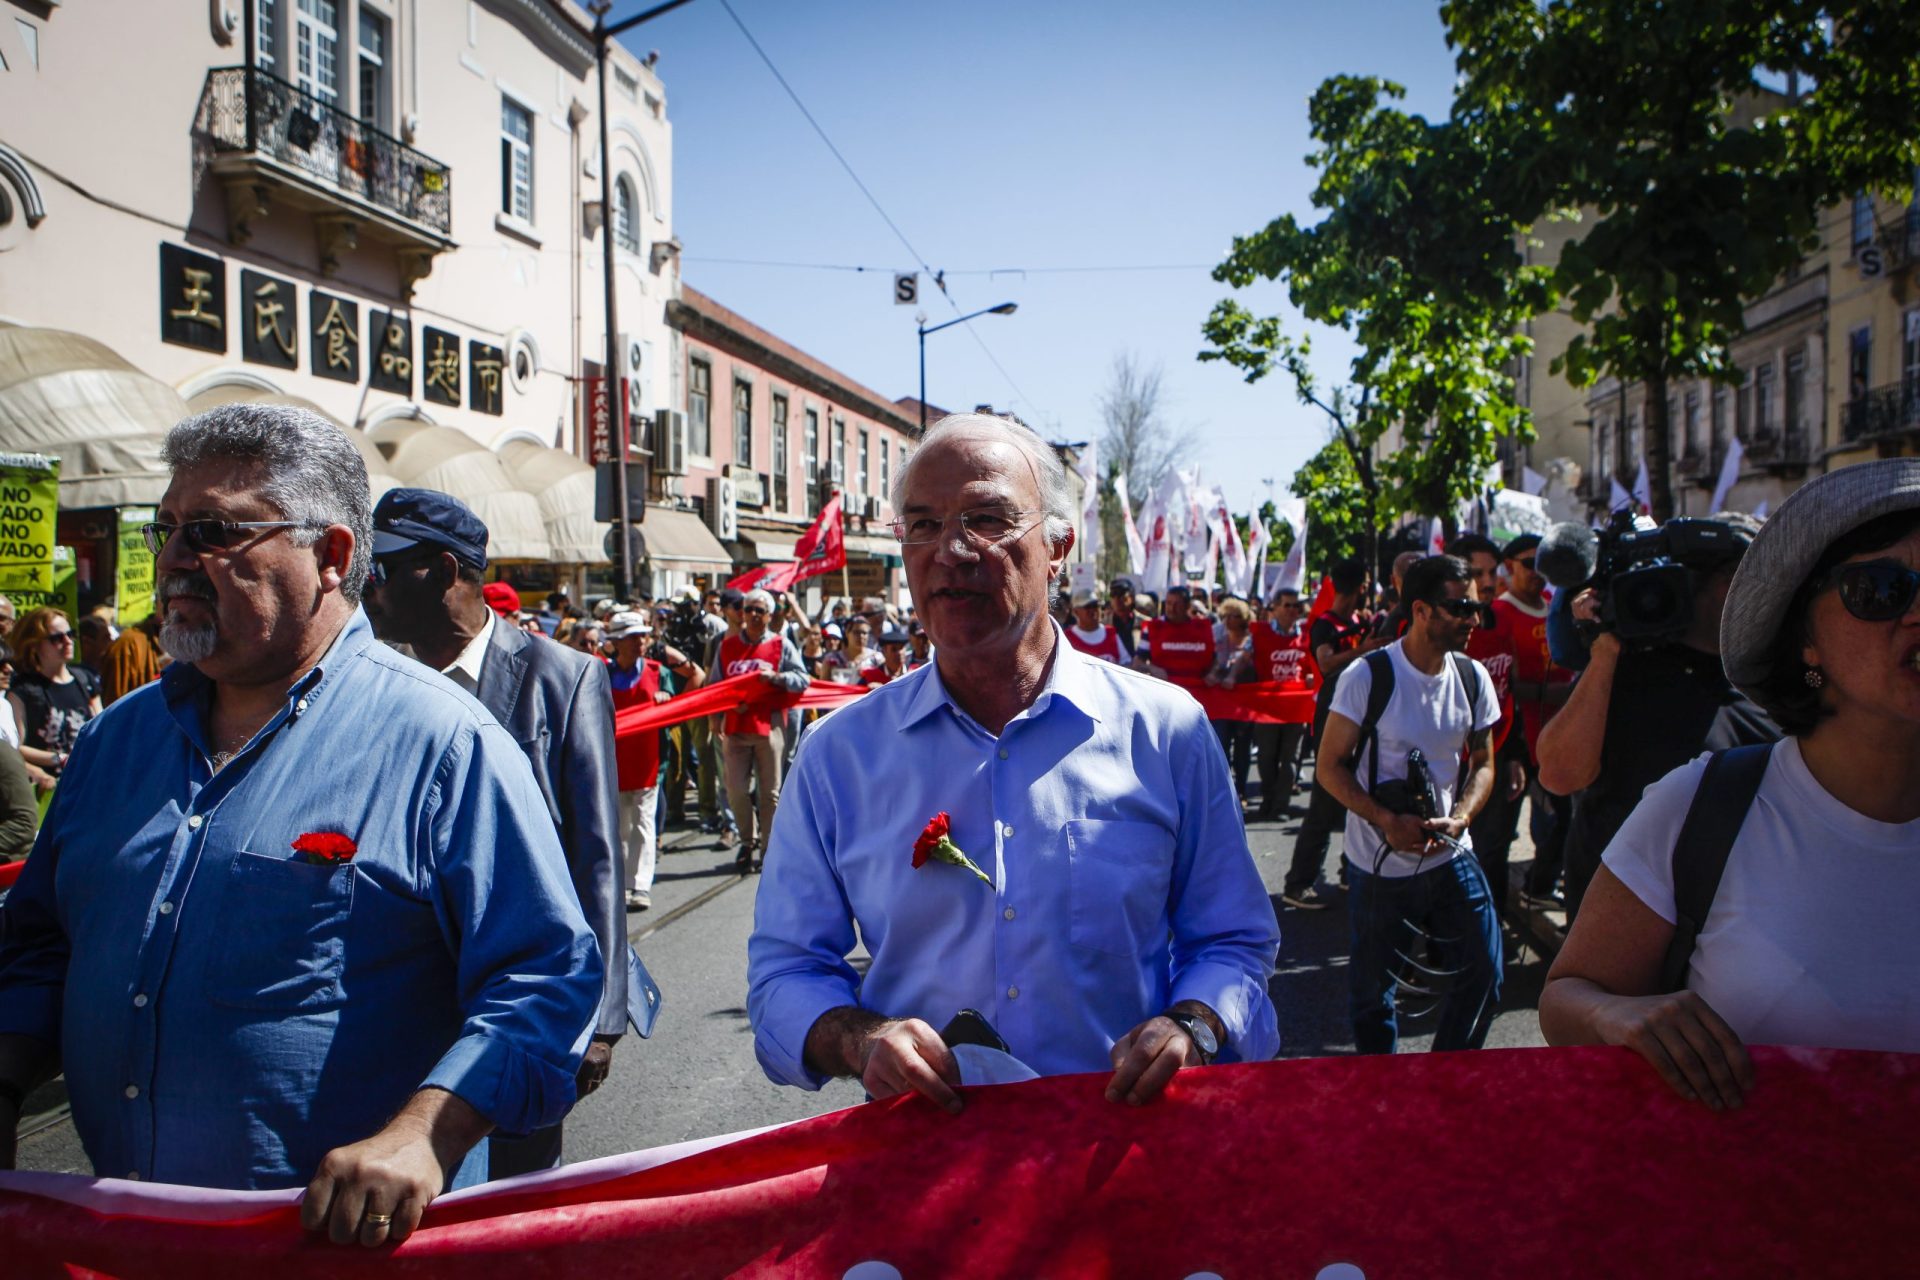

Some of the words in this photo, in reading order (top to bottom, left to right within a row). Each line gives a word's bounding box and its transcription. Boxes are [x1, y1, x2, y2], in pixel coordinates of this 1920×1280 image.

[1861, 249, 1881, 275] S
[897, 276, 915, 302] S
[3, 487, 31, 503] NO
[0, 505, 43, 523] ADO
[1, 523, 30, 540] NO
